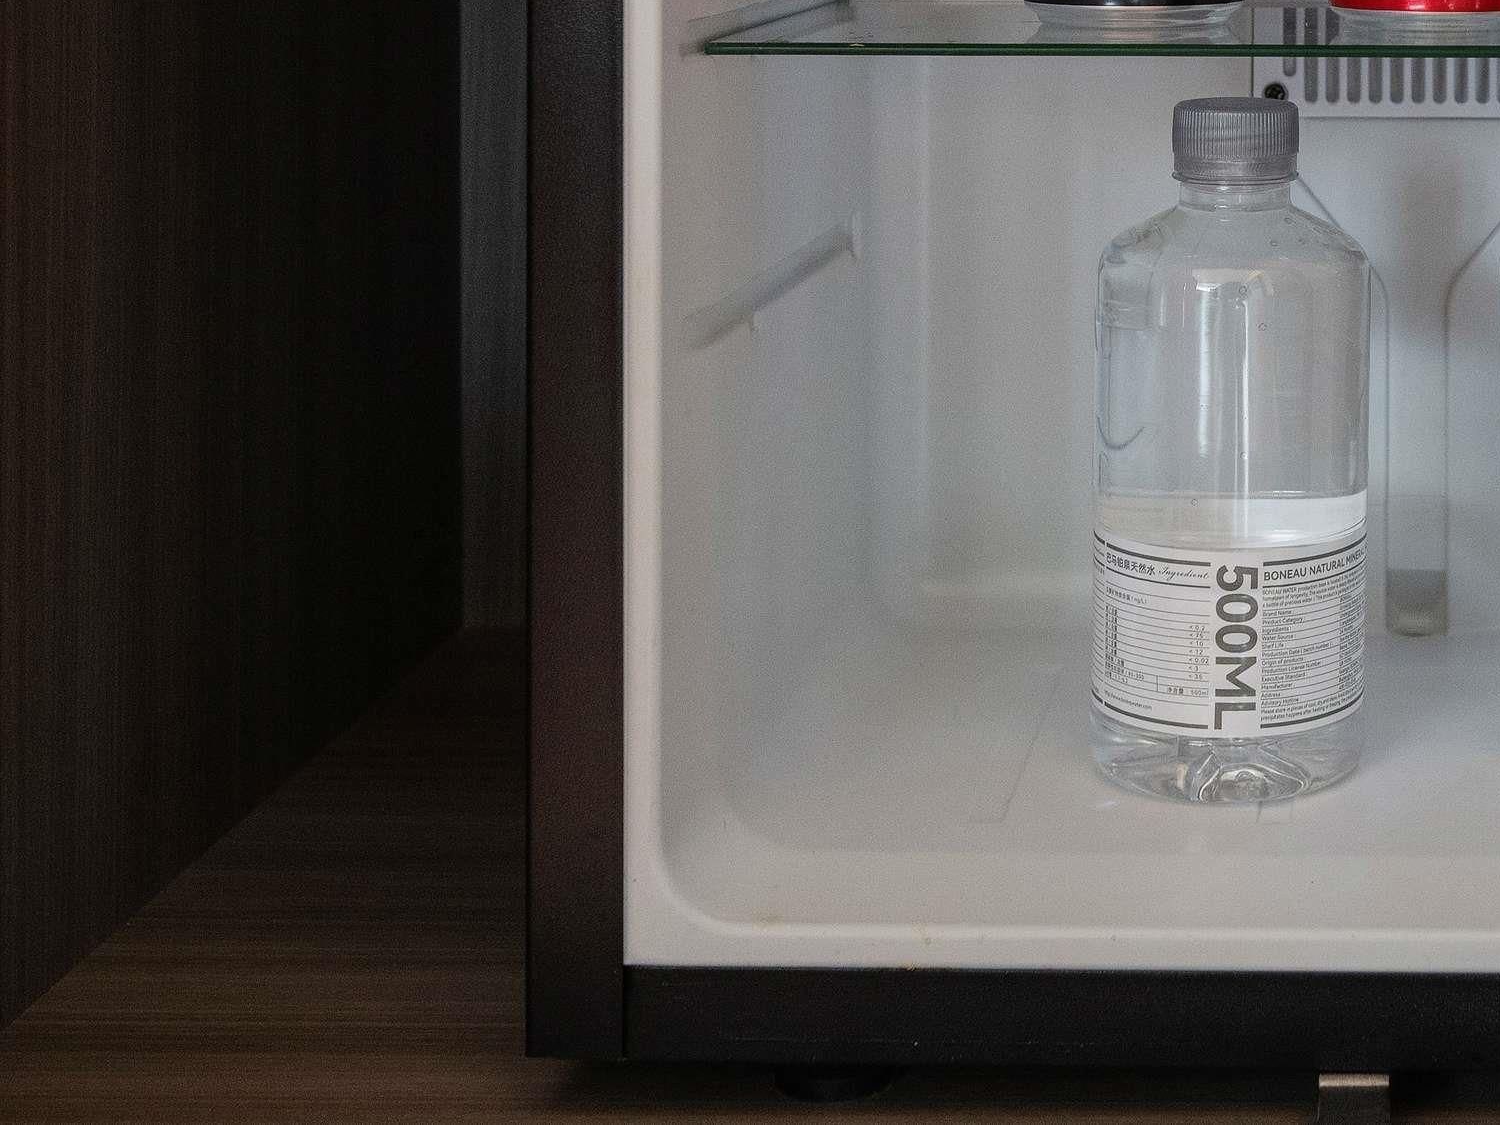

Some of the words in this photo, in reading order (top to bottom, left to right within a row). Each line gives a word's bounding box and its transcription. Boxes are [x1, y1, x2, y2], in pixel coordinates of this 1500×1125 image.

[1264, 567, 1307, 581] BONEAU
[1309, 558, 1345, 575] NATURAL
[1214, 565, 1258, 730] 500ML
